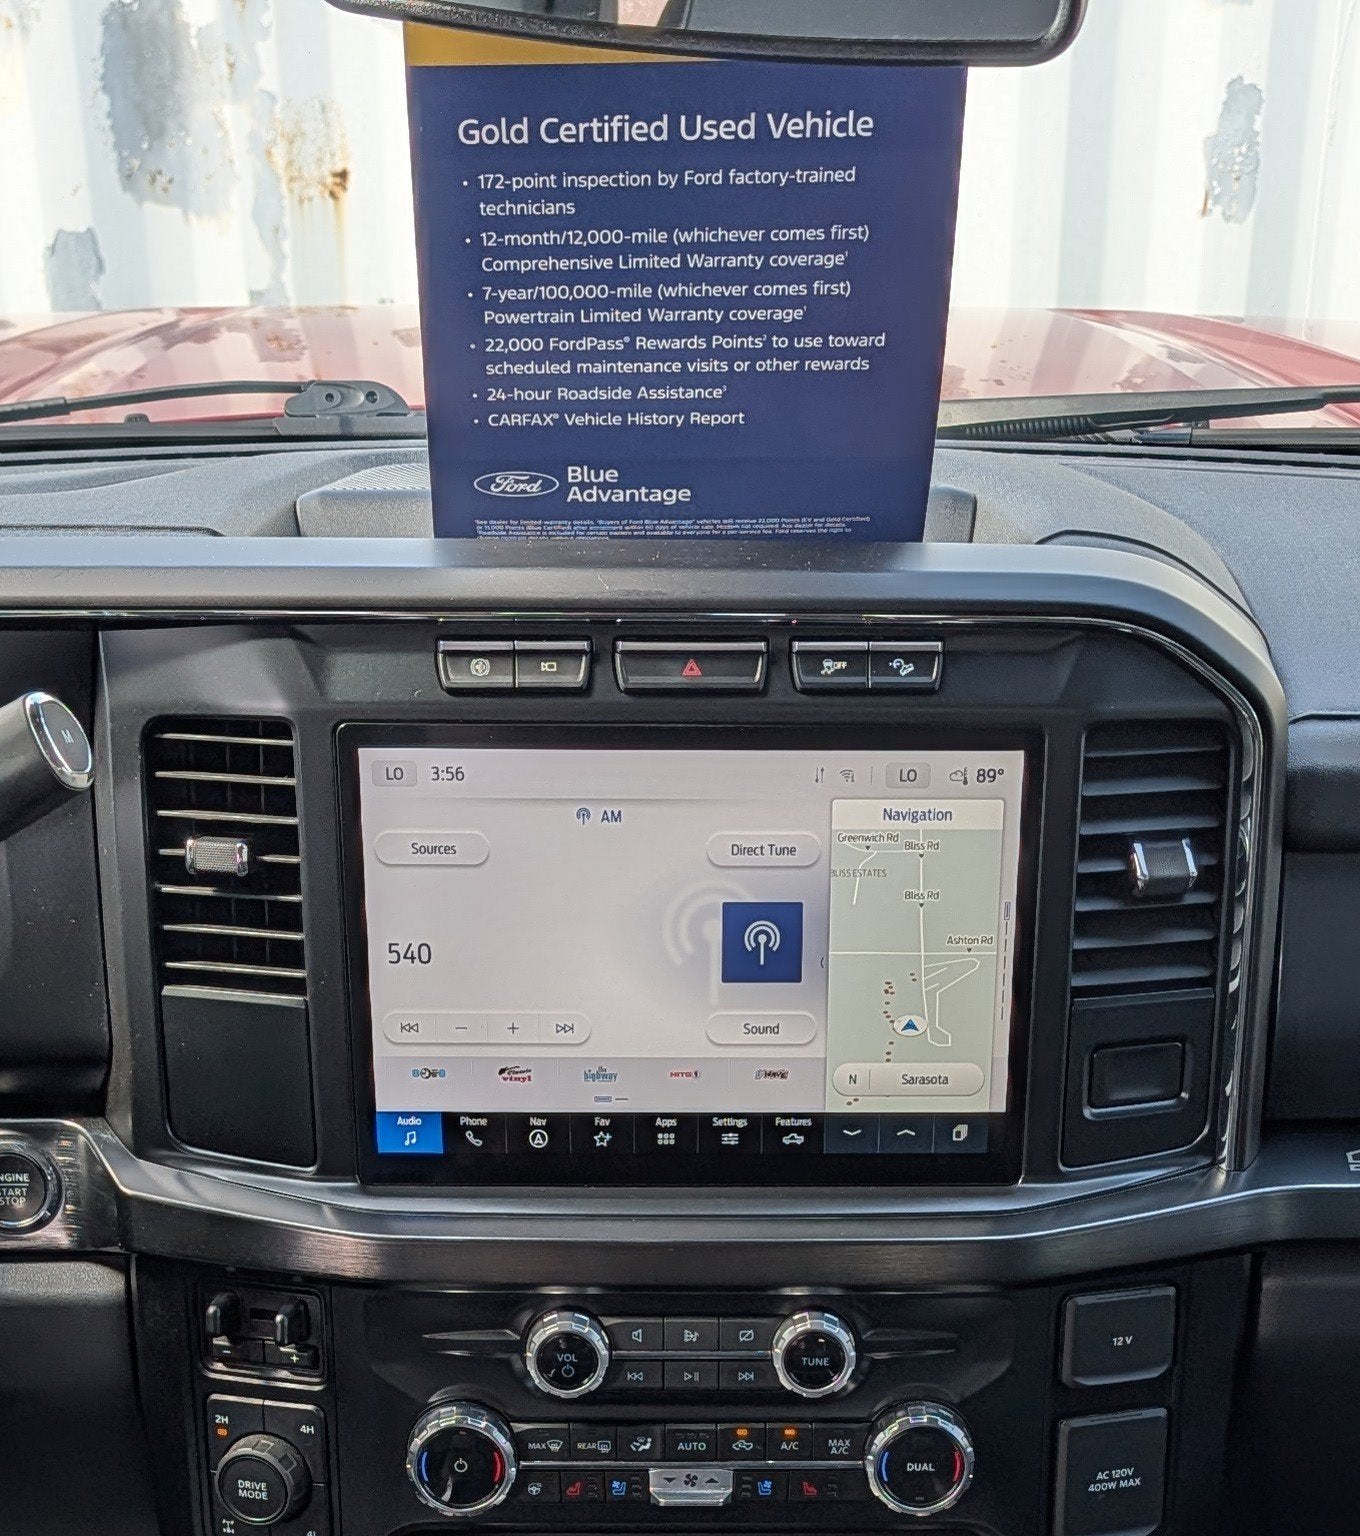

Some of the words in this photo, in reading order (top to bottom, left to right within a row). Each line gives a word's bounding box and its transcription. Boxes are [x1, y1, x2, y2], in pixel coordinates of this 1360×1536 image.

[458, 116, 528, 145] Gold
[539, 113, 668, 143] Certified
[679, 113, 756, 142] Used
[768, 110, 874, 138] Vehicle
[477, 170, 557, 190] 172-point
[562, 169, 652, 190] inspection
[657, 170, 678, 189] by
[683, 169, 723, 186] Ford
[728, 166, 856, 187] factory-trained
[480, 198, 576, 217] technicians
[480, 228, 668, 249] 12-month/12,000-mile
[672, 225, 766, 247] (whichever
[770, 228, 826, 242] comes
[830, 223, 870, 243] first)
[482, 255, 613, 276] Comprehensive
[618, 253, 682, 270] Limited
[686, 252, 765, 272] Warranty
[482, 284, 652, 302] 7-year/100,000-mile
[657, 283, 748, 300] (whichever
[753, 285, 808, 297] comes
[812, 280, 852, 298] first)
[484, 309, 576, 326] Powertrain
[580, 307, 642, 323] Limited
[646, 306, 724, 325] Warranty
[485, 337, 544, 354] 22,000
[635, 334, 708, 350] Rewards
[771, 335, 789, 349] to
[794, 336, 823, 349] use
[827, 333, 886, 348] toward
[485, 359, 571, 375] scheduled
[576, 359, 682, 374] maintenance
[687, 358, 729, 373] visits
[733, 360, 751, 372] or
[755, 357, 799, 372] other
[804, 355, 870, 371] rewards
[487, 387, 552, 401] 24-hour
[557, 385, 632, 400] Roadside
[564, 412, 623, 426] Vehicle
[627, 411, 686, 428] History
[690, 410, 745, 427] Report
[567, 467, 619, 483] Blue
[490, 474, 542, 494] Ford
[566, 486, 692, 504] Advantage
[385, 767, 404, 782] LO
[431, 766, 465, 783] 3:56
[899, 768, 918, 783] LO
[601, 810, 623, 824] AM
[882, 807, 953, 824] Navigation
[837, 832, 885, 843] Greenwich
[886, 832, 899, 843] Rd
[411, 842, 457, 856] Sources
[730, 843, 764, 857] Direct
[767, 843, 797, 857] Tune
[904, 840, 926, 851] Bliss
[926, 840, 940, 851] Rd
[904, 890, 926, 900] Bliss
[926, 890, 940, 900] Rd
[946, 936, 979, 945] Ashton
[980, 936, 994, 945] Rd
[387, 942, 432, 966] 540
[743, 1022, 780, 1037] Sound
[848, 1073, 858, 1086] N
[901, 1073, 949, 1087] Sarasota
[397, 1116, 421, 1127] Audio
[459, 1116, 488, 1127] Phone
[529, 1116, 548, 1127] Nav
[594, 1116, 611, 1127] Fav
[655, 1116, 677, 1129] Apps
[712, 1116, 748, 1129] Settings
[775, 1116, 812, 1127] Features
[556, 1353, 578, 1363] VOL
[801, 1357, 830, 1367] TUNE
[214, 1414, 229, 1425] 2H
[299, 1425, 315, 1435] 4H
[528, 1442, 547, 1450] MAX
[577, 1443, 598, 1451] REAR
[677, 1441, 707, 1451] AUTO
[780, 1441, 800, 1452] A/C
[828, 1438, 851, 1447] MAX
[830, 1446, 850, 1455] A/C
[906, 1462, 936, 1473] DUAL
[1096, 1470, 1110, 1481] AC
[1111, 1467, 1135, 1479] 120V
[237, 1479, 268, 1492] DRIVE
[1088, 1481, 1117, 1492] 400W
[1119, 1477, 1141, 1489] MAX
[238, 1489, 269, 1501] MODE
